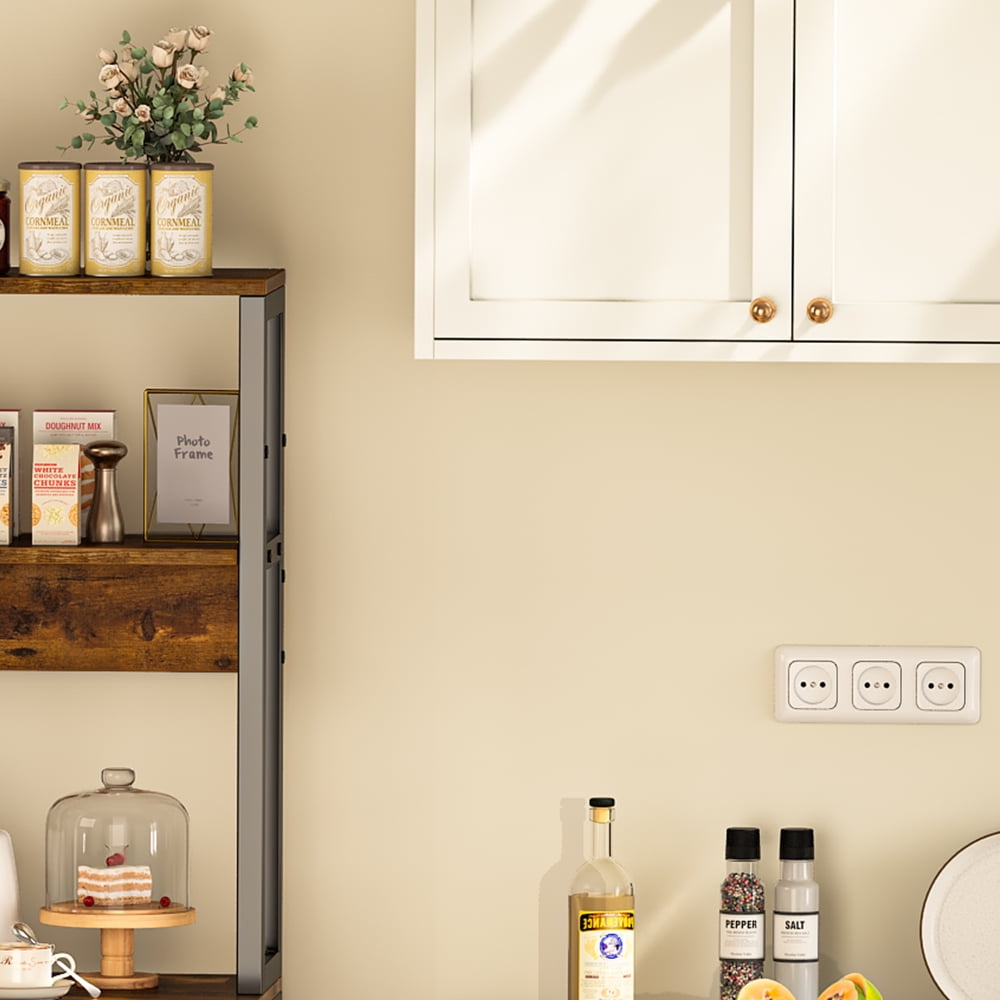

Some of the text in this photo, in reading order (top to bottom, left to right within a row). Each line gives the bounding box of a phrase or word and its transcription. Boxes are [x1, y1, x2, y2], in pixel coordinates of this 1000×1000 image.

[25, 184, 66, 215] Organic
[91, 184, 132, 215] Organic
[156, 185, 199, 217] Organic
[26, 217, 70, 226] CORNMEAL
[91, 217, 136, 227] CORNMEAL
[157, 218, 202, 227] CORNMEAL
[45, 422, 102, 430] DOUGHNUT MIX
[177, 434, 211, 447] Photo
[174, 448, 214, 460] Frame
[725, 920, 757, 929] PEPPER
[785, 920, 806, 930] SALT
